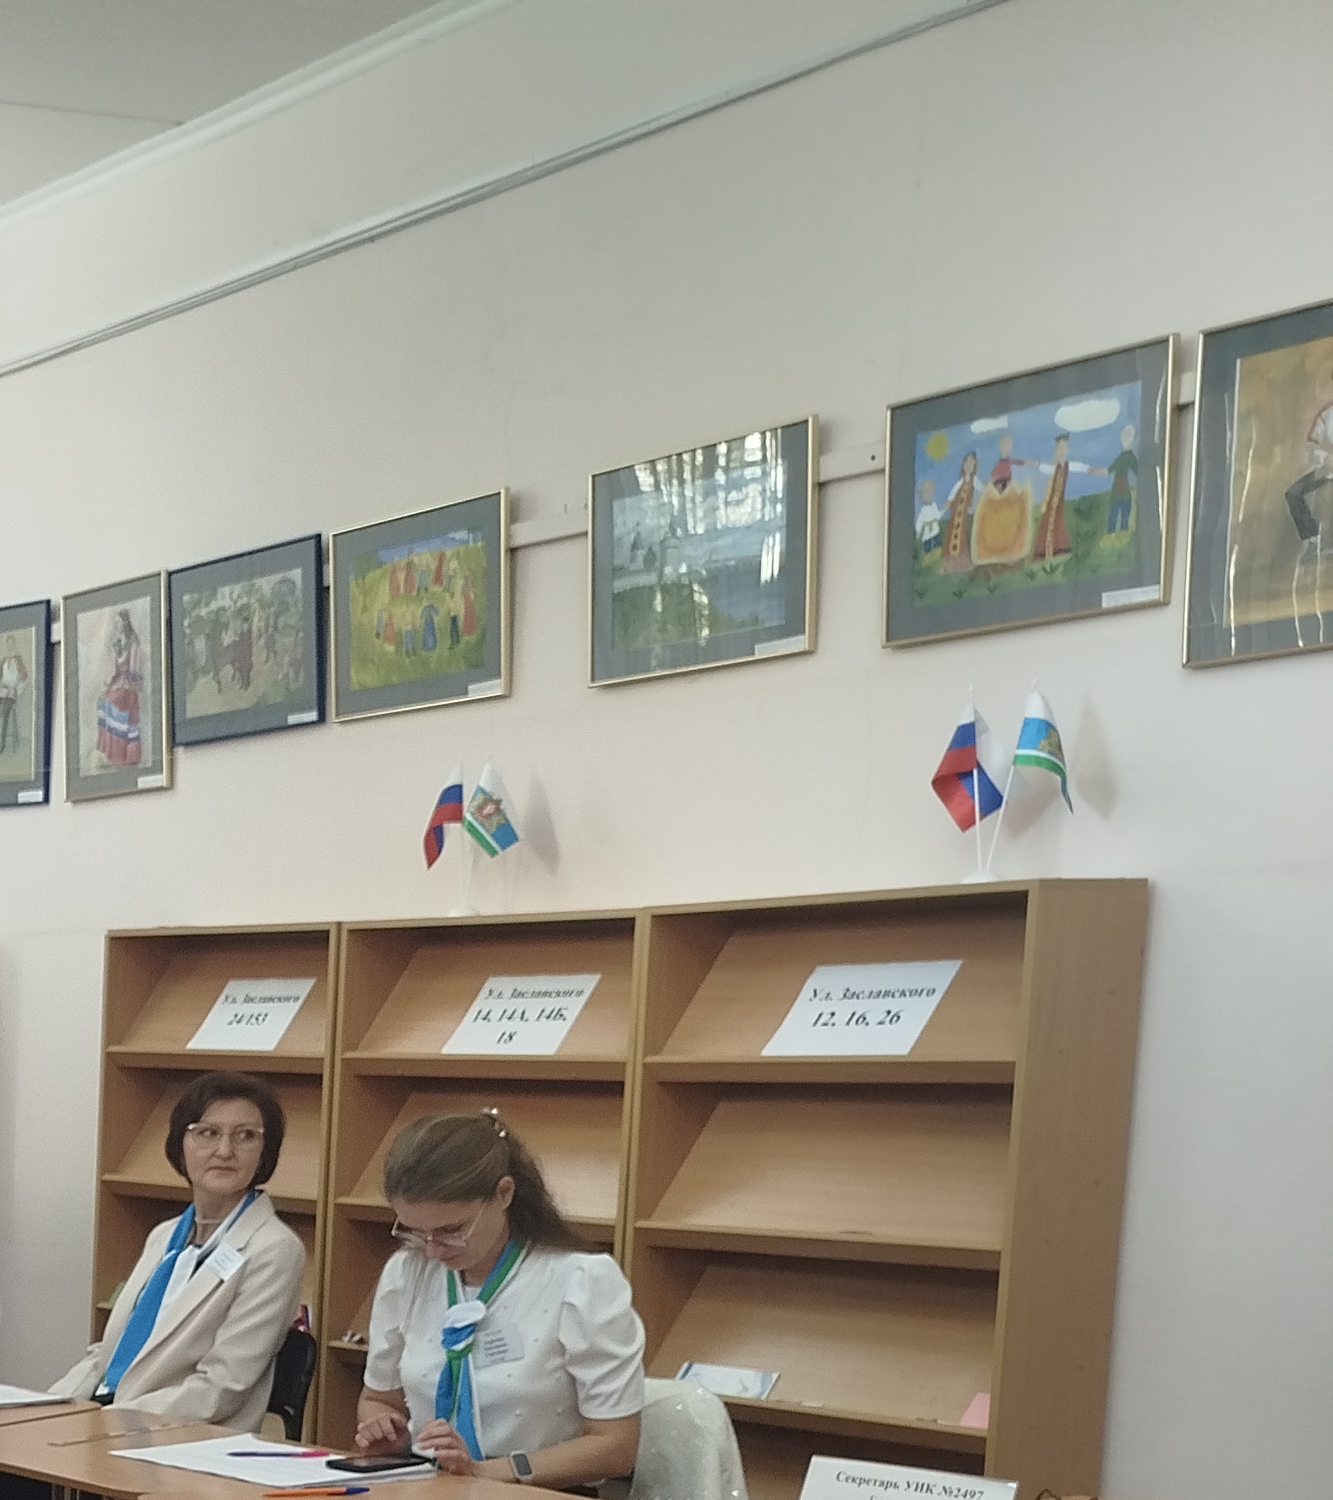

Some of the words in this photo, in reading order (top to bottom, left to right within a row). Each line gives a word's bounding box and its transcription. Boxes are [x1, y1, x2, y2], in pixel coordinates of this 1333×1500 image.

[838, 986, 936, 1002] Заславского
[844, 1009, 870, 1027] 16,
[876, 1008, 905, 1026] 26
[496, 1030, 517, 1045] 18
[836, 1471, 900, 1491] Секретарь
[904, 1480, 936, 1495] УИК
[937, 1485, 985, 1500] №2497
